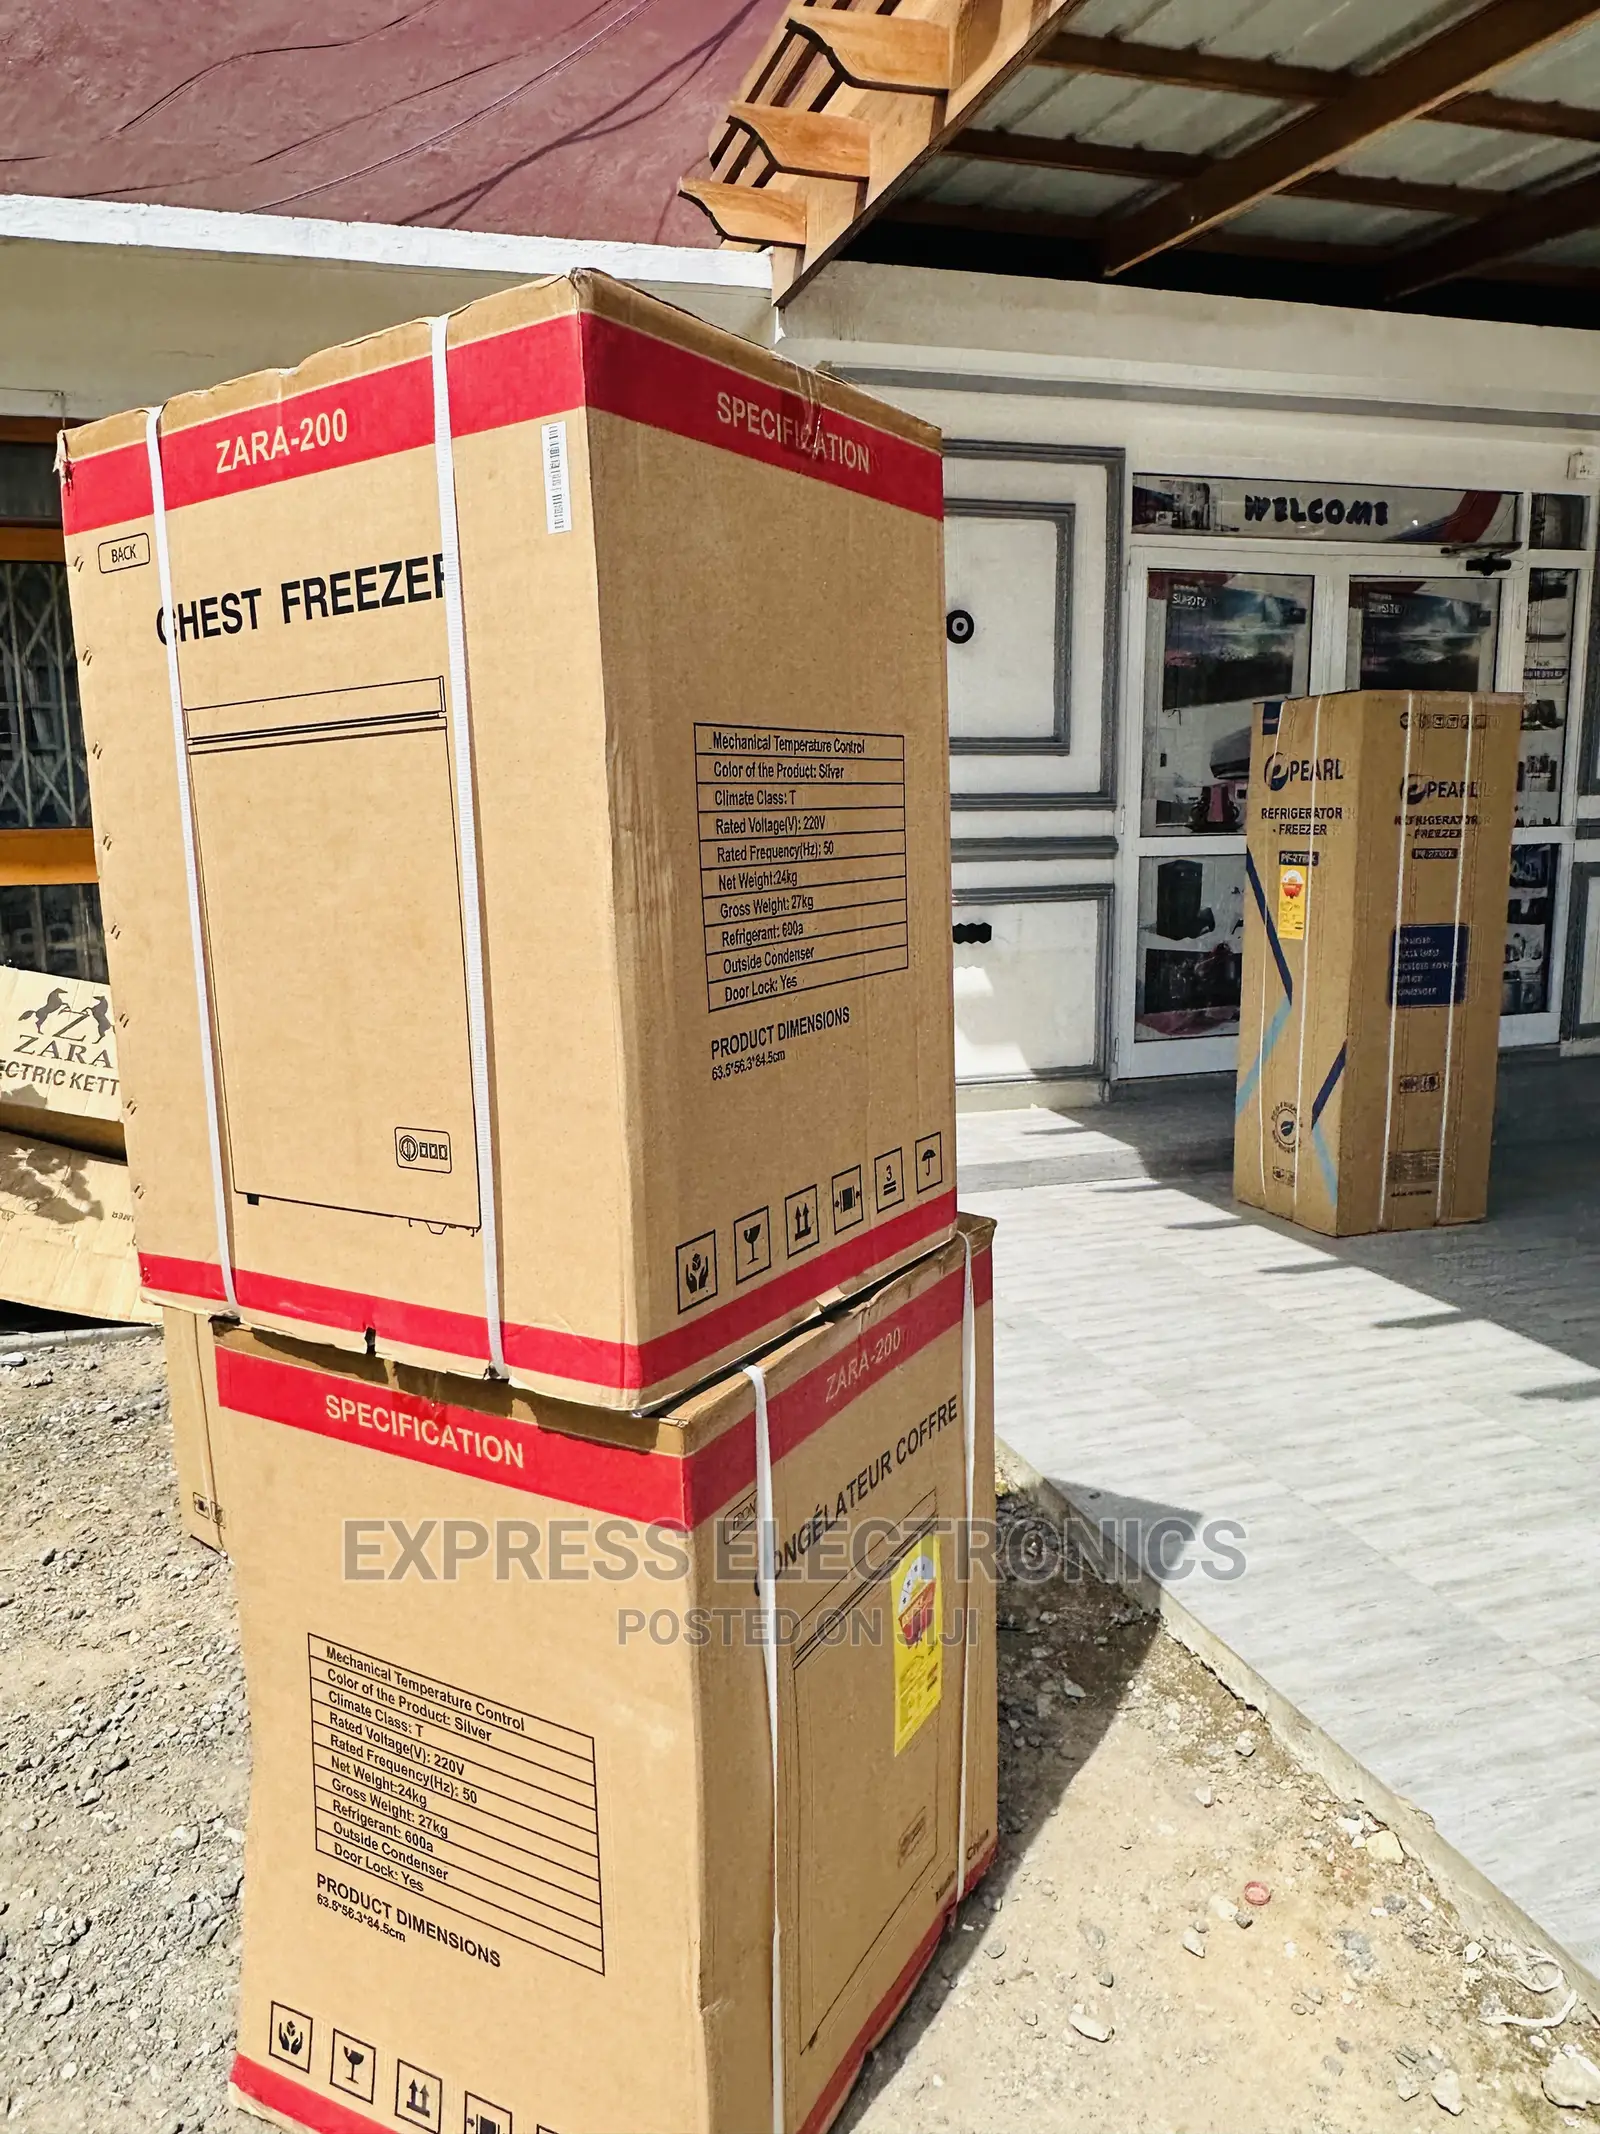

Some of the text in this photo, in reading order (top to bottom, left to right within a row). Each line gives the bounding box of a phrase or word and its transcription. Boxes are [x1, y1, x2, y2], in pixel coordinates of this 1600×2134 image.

[215, 408, 348, 474] ZARA-200
[717, 391, 870, 474] SPECIFICATION
[1244, 494, 1389, 526] WELCOME
[111, 543, 137, 564] BACK
[713, 731, 865, 755] Mechanical Temperature Control
[714, 761, 844, 779] Color of the Product: Silver
[1290, 758, 1344, 782] PEARL
[714, 790, 797, 806] Climate Class: T
[1261, 807, 1343, 820] REFRIGERATOR
[716, 815, 826, 835] Rated Voltage(V): 220V
[1279, 823, 1327, 836] FREEZER
[717, 840, 834, 863] Rated Frequency(Hz): 50
[719, 874, 736, 891] Net
[720, 895, 814, 919] Gross Weight: 27kg
[722, 920, 804, 947] Refrigerant: 600a
[723, 947, 815, 974] Outside Condenser
[725, 973, 798, 1002] Door Lock: Yes
[711, 1006, 850, 1060] PRODUCT DIMENSIONS
[13, 1034, 114, 1069] ZARA
[826, 1327, 900, 1403] ZARA-200
[325, 1393, 524, 1469] SPECIFICATION
[754, 1395, 958, 1597] ONGÉLATEUR COFFRE
[326, 1645, 525, 1732] Mechanical Temperature Control
[327, 1668, 492, 1742] Color of the Product: Silver
[329, 1690, 424, 1738] Climate Class: T
[329, 1711, 465, 1776] Rated Voltage(V): 220V
[330, 1733, 477, 1804] Rated Frequency(Hz): 50
[331, 1755, 351, 1774] Net
[332, 1778, 448, 1839] Gross Weight: 27kg
[333, 1799, 434, 1853] Refrigerant: 600a
[333, 1821, 448, 1880] Outside Condenser
[334, 1842, 424, 1892] Door Lock: Yes
[317, 1873, 501, 1968] PRODUCT DIMENSIONS
